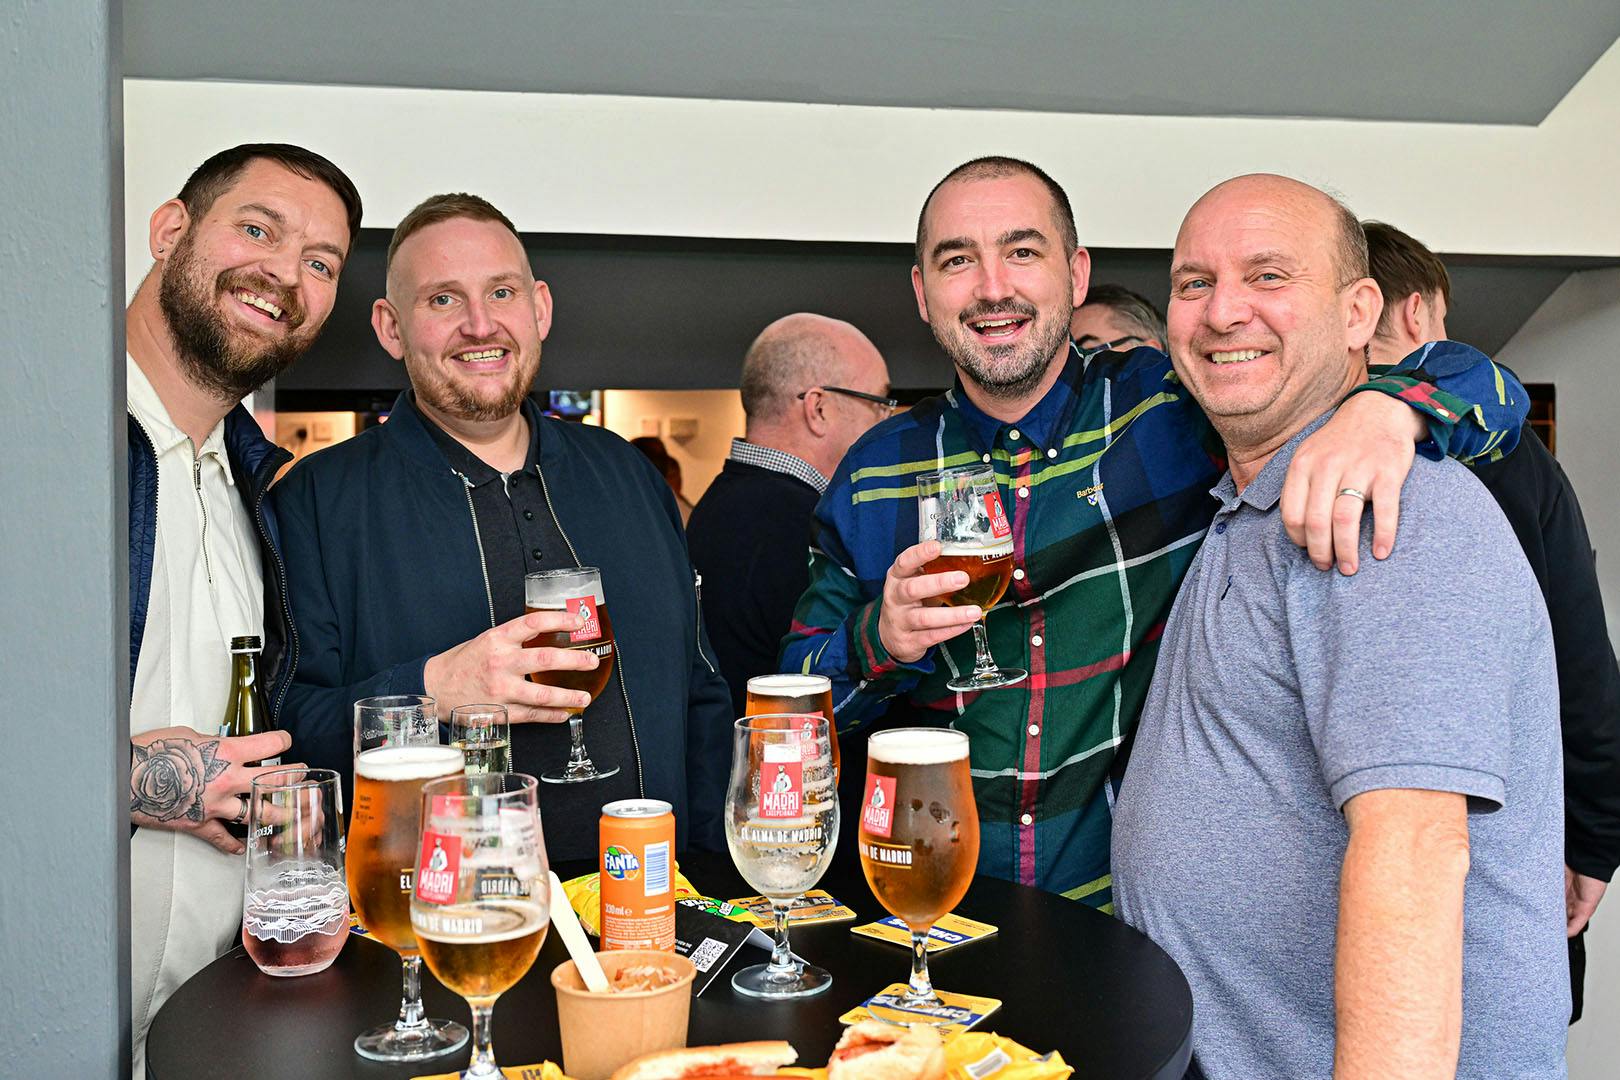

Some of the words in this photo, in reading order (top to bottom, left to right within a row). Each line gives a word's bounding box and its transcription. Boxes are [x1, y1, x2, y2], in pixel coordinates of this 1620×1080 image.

[1077, 482, 1104, 498] Barbour
[752, 829, 774, 842] ALMA
[777, 829, 788, 842] DE
[791, 827, 822, 842] MADRID
[604, 853, 639, 870] FANTA
[880, 847, 912, 865] MADRID
[401, 875, 412, 889] EL
[442, 918, 483, 934] MADRID
